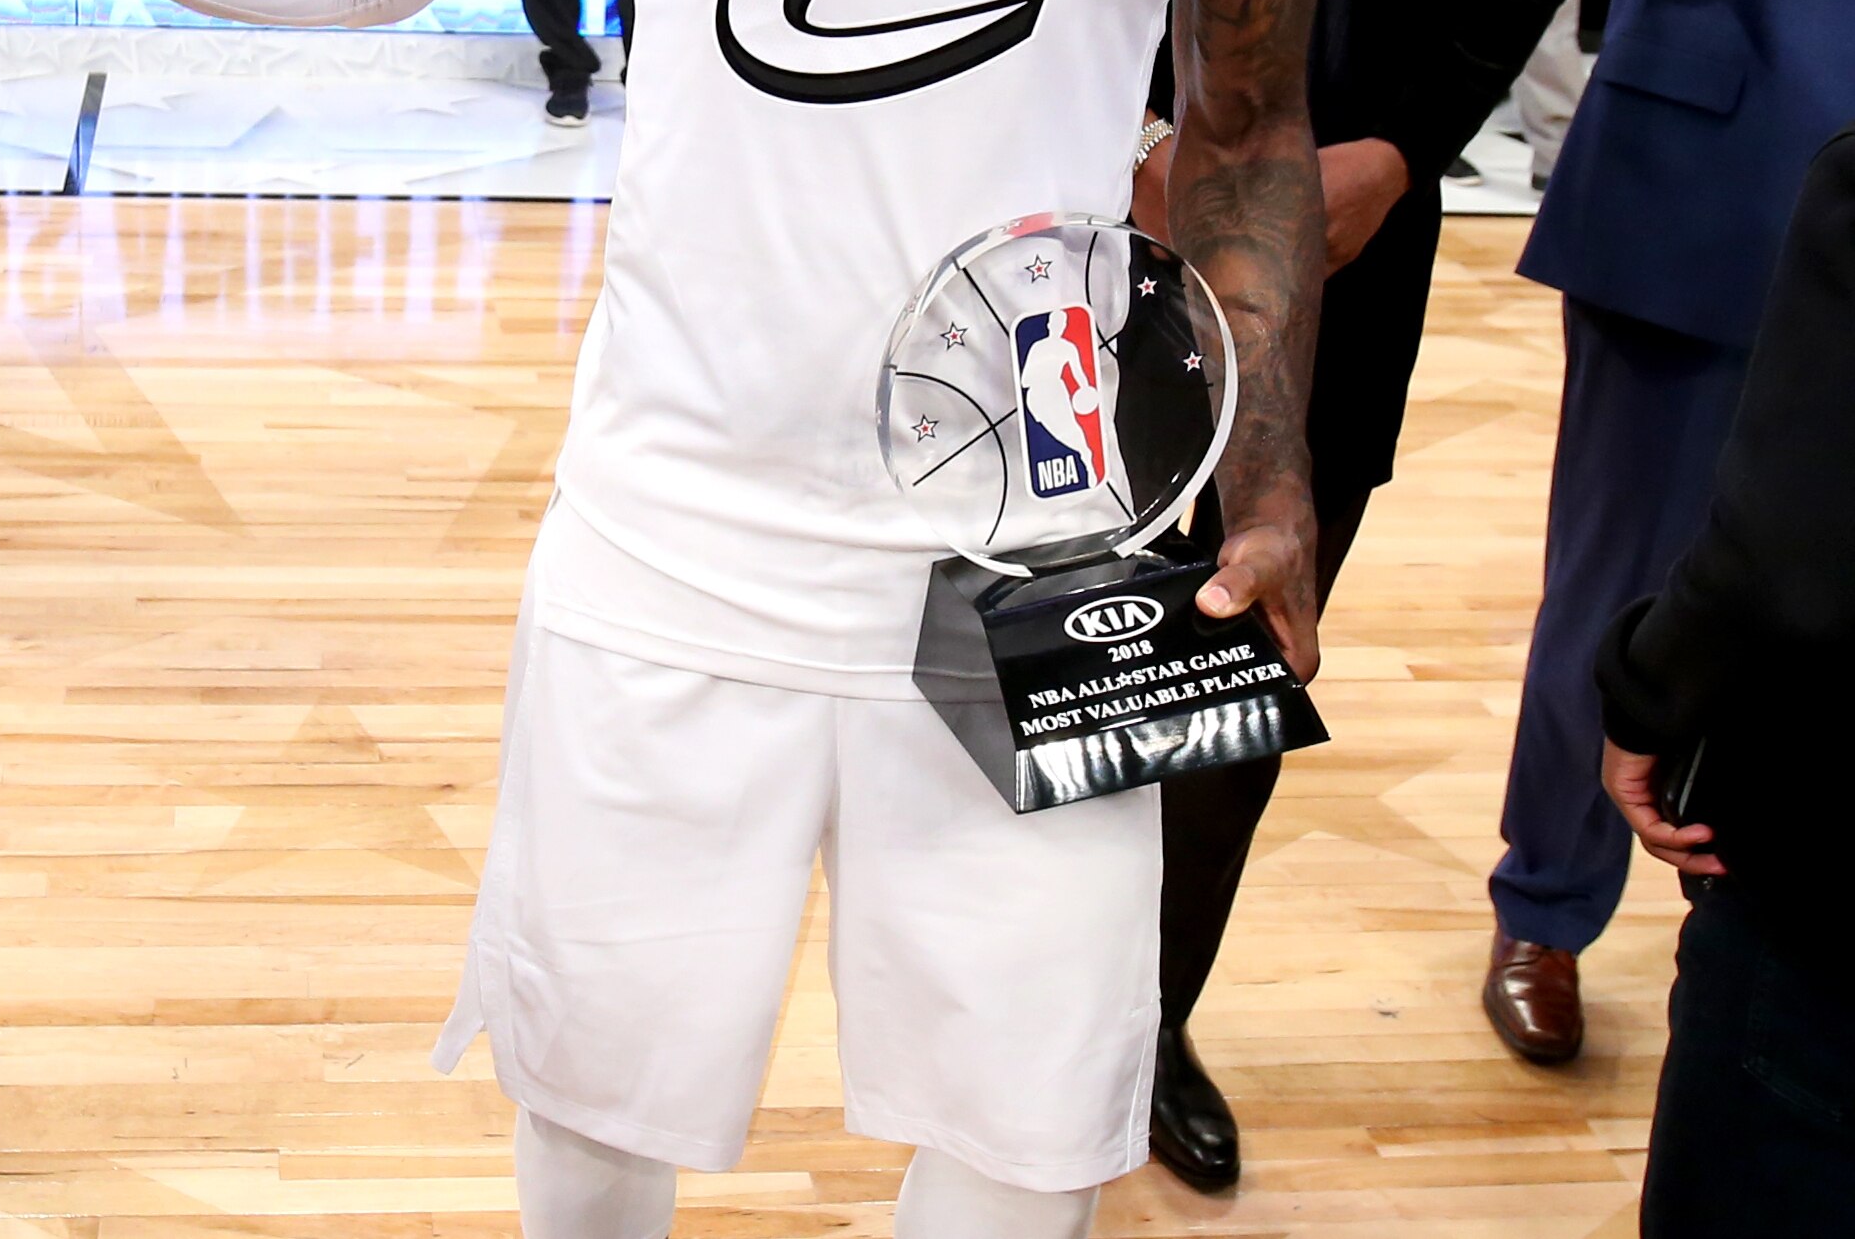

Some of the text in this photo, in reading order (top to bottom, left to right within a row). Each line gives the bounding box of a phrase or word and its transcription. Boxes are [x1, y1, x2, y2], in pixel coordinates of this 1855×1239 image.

[1037, 454, 1080, 492] NBA
[1077, 602, 1152, 638] KIA
[1107, 639, 1154, 663] 2018
[1028, 686, 1076, 710] NBA
[1189, 644, 1255, 670] GAME
[1019, 662, 1287, 737] MOST VALUABLE PLAYER
